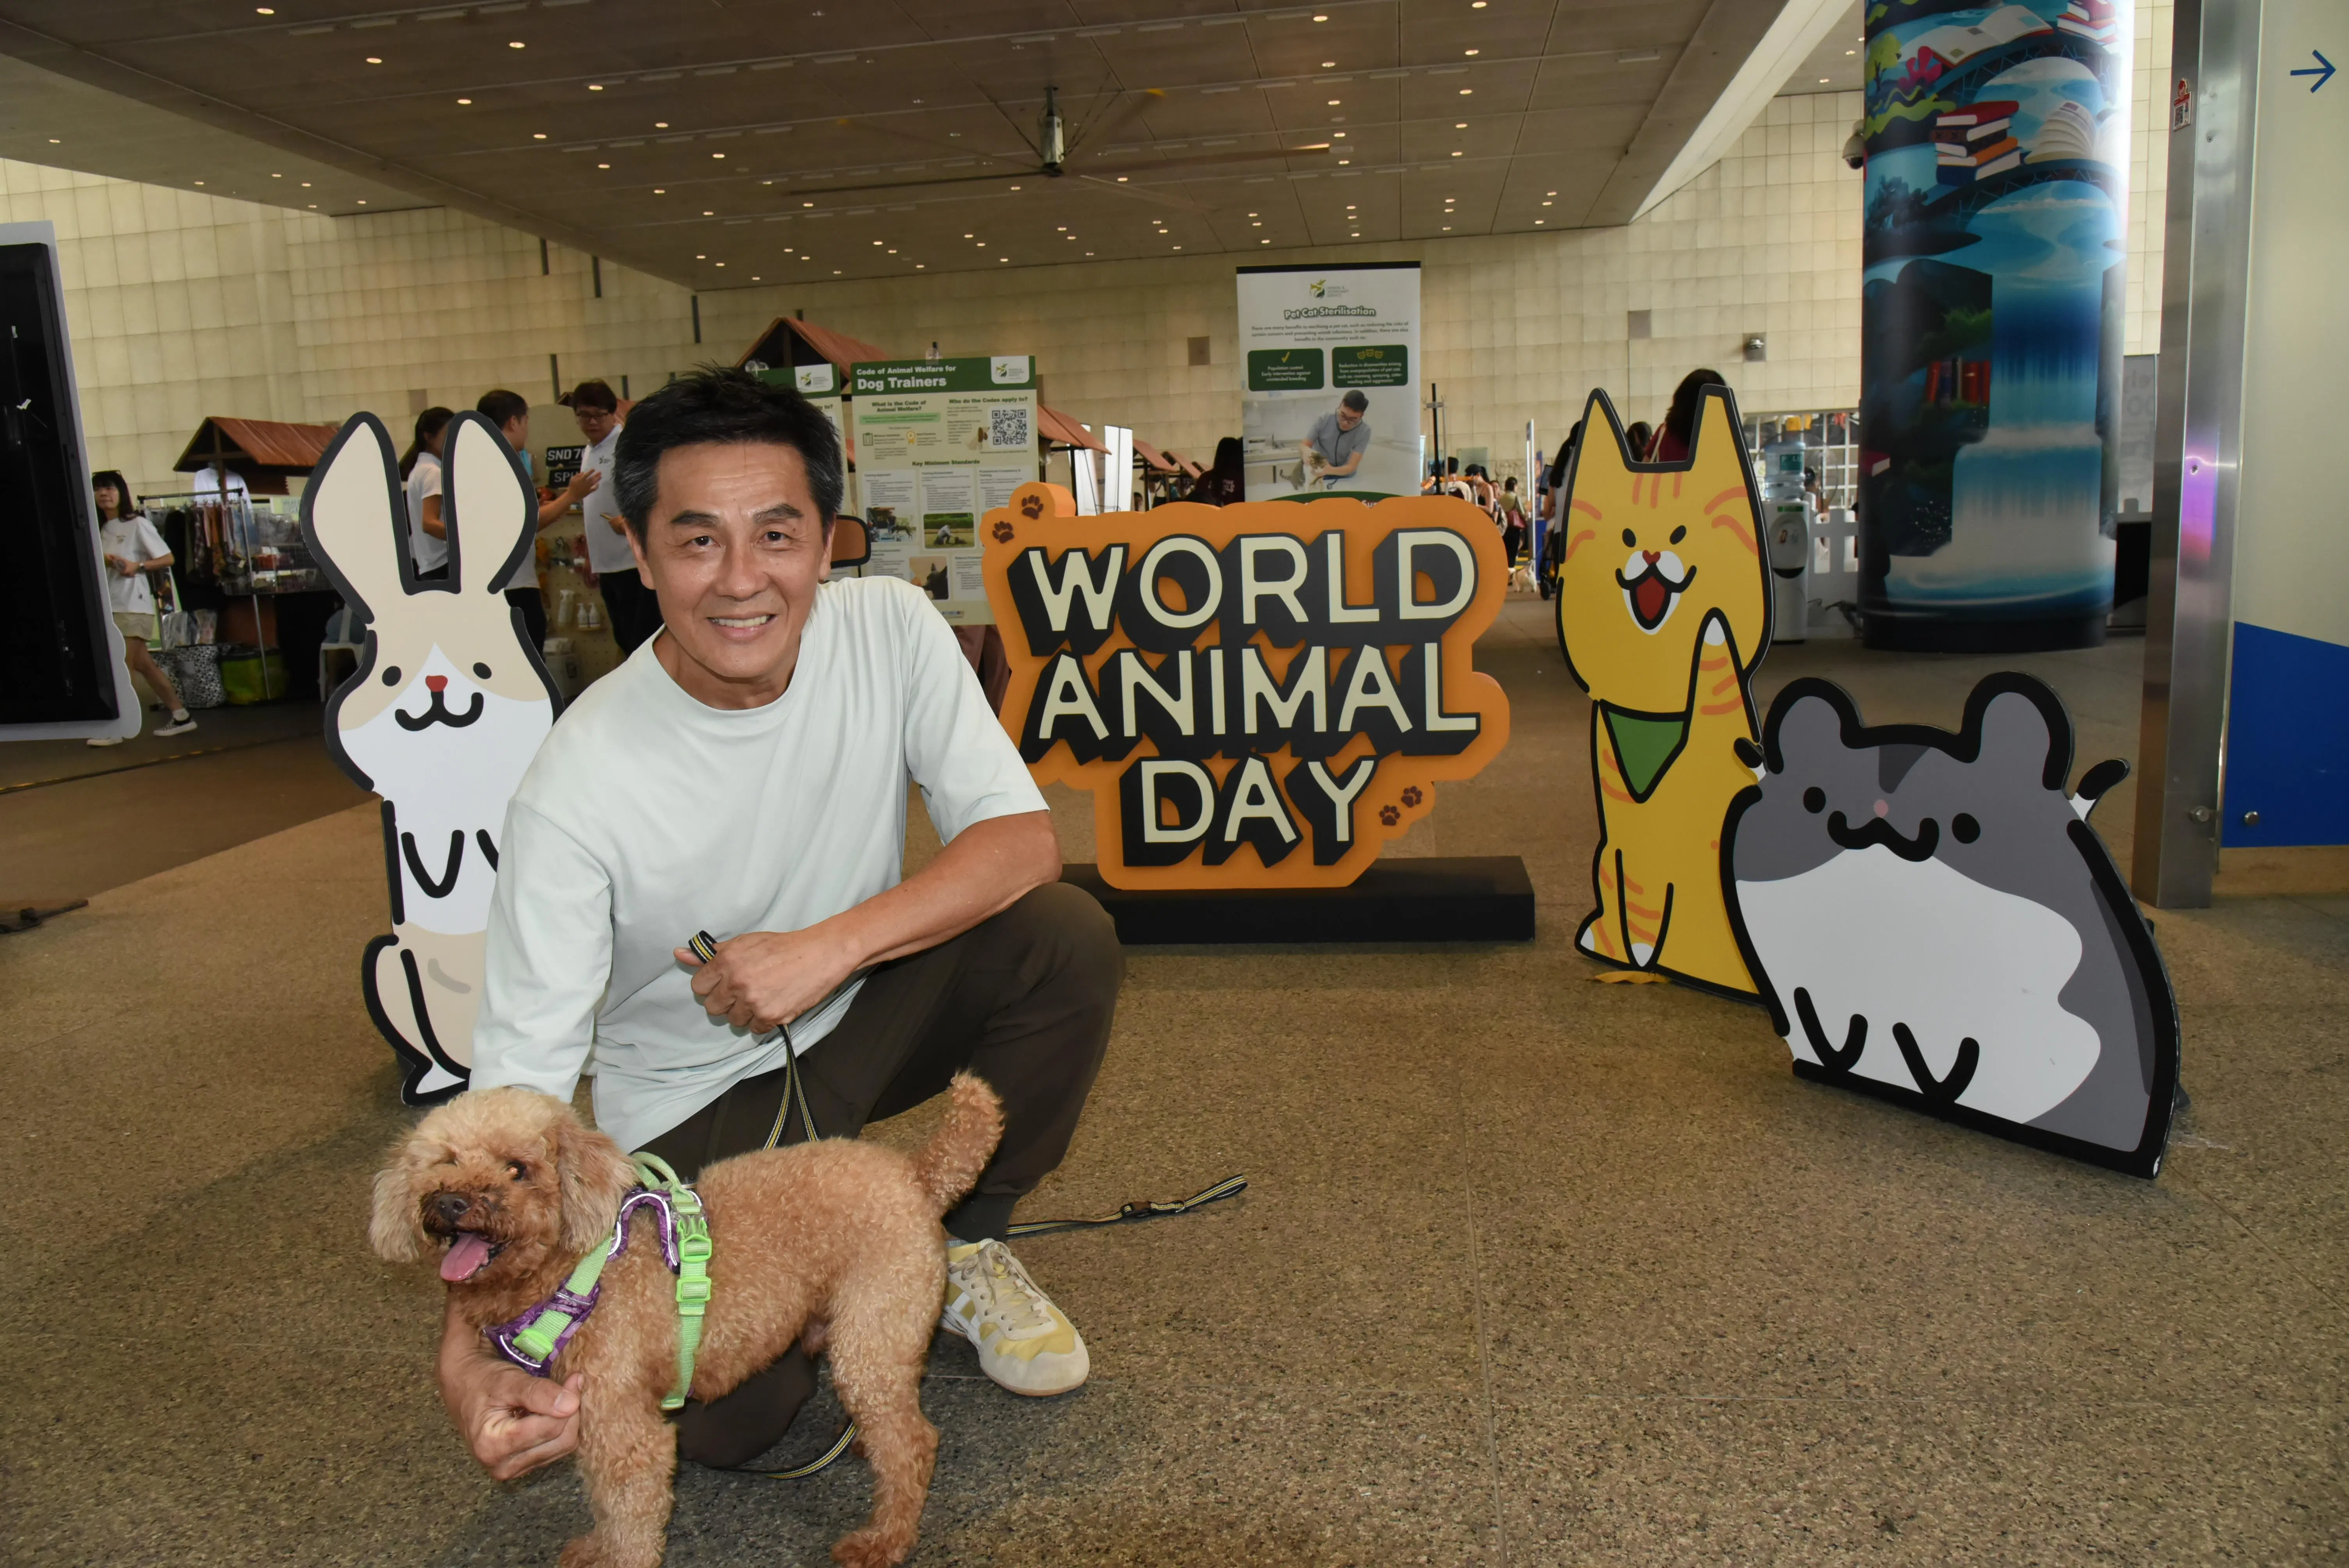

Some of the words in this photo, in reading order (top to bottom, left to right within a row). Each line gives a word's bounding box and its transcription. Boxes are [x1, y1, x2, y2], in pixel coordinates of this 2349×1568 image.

[1285, 308, 1300, 319] Pet
[1302, 307, 1317, 317] Cat
[1319, 306, 1375, 316] Sterilisation
[857, 378, 884, 391] Dog
[888, 376, 946, 388] Trainers
[548, 449, 572, 460] SND
[1028, 531, 1475, 631] WORLD
[1039, 643, 1477, 740] ANIMAL
[1141, 757, 1374, 842] DAY
